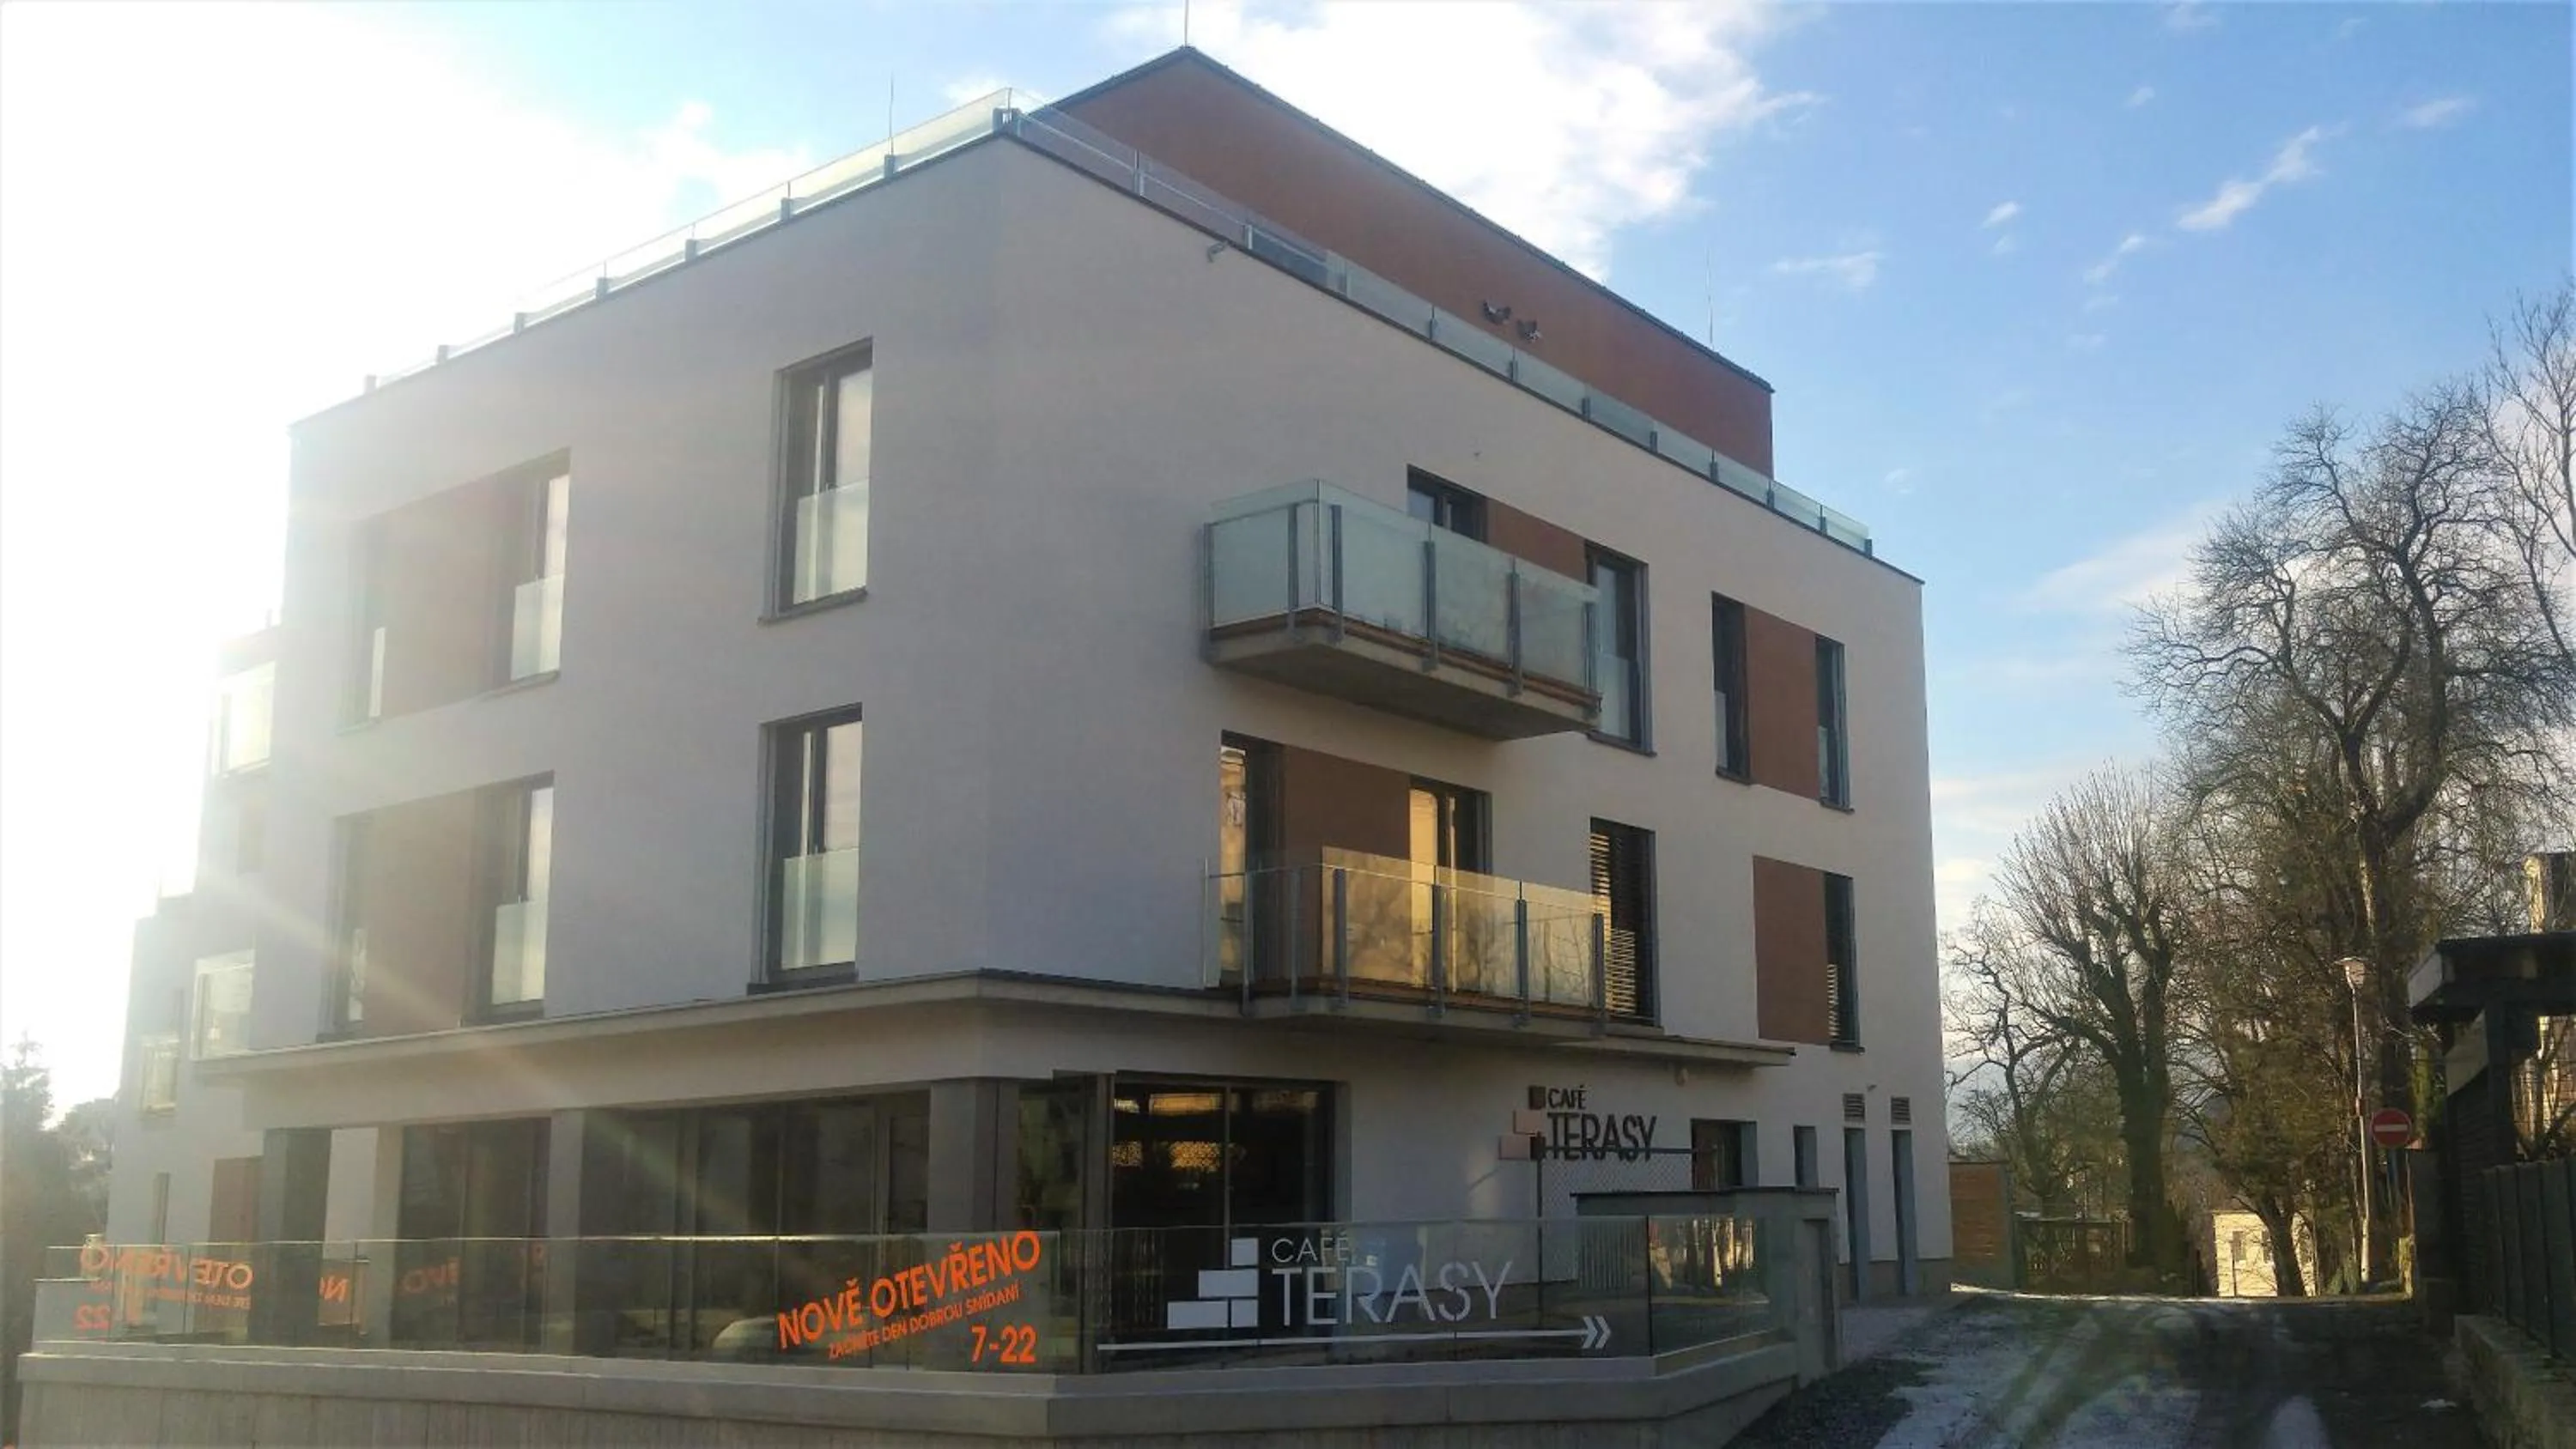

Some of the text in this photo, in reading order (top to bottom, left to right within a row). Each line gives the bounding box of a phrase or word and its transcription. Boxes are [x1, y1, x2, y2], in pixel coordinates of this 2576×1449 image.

[1548, 1084, 1588, 1109] CAFÉ
[1546, 1113, 1657, 1161] TERASY
[1272, 1230, 1349, 1263] CAFÉ
[779, 1230, 1041, 1349] NOVĚ OTEVŘENO
[1272, 1260, 1513, 1326] TERASY
[971, 1325, 1036, 1363] 7-22
